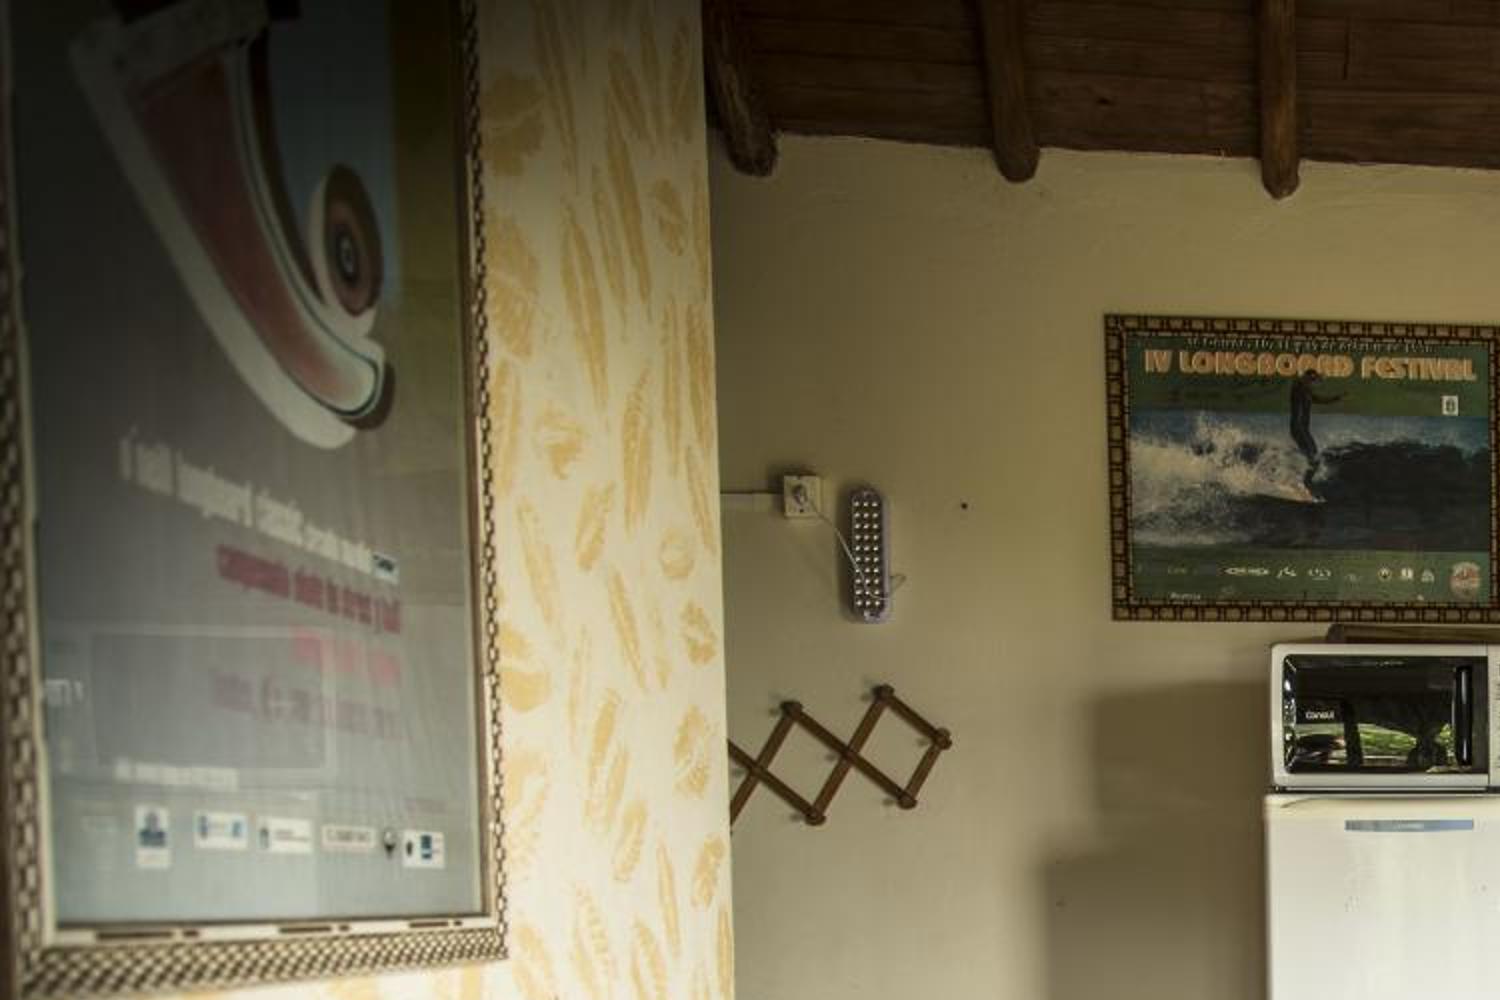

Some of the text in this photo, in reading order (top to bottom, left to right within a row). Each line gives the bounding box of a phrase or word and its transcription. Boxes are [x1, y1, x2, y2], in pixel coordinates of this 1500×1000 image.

[1144, 349, 1476, 381] IV LONGBOARD FESTIVAL
